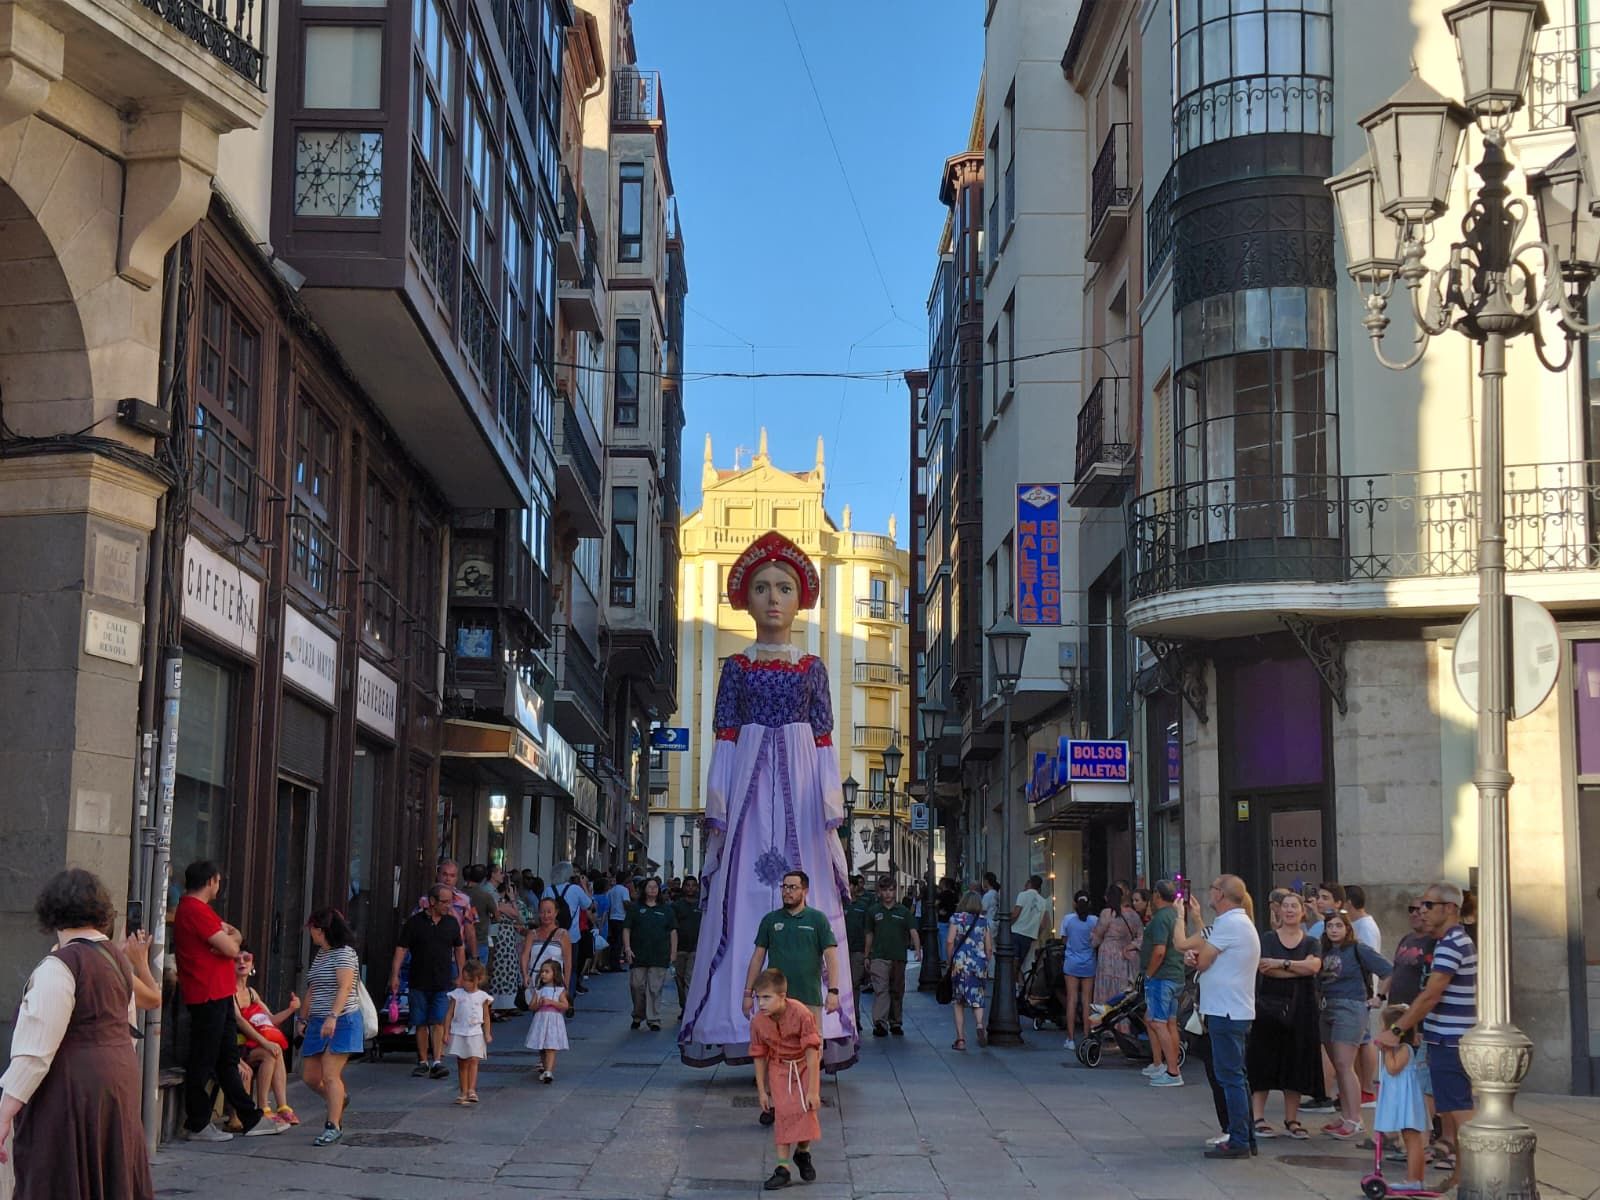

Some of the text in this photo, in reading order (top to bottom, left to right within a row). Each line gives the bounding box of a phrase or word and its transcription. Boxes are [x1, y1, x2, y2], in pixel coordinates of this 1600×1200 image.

[1020, 520, 1038, 621] MALETAS
[1041, 520, 1059, 622] BOLSOS
[106, 620, 128, 634] CALLE
[1073, 746, 1123, 760] BOLSOS
[1071, 763, 1126, 778] MALETAS
